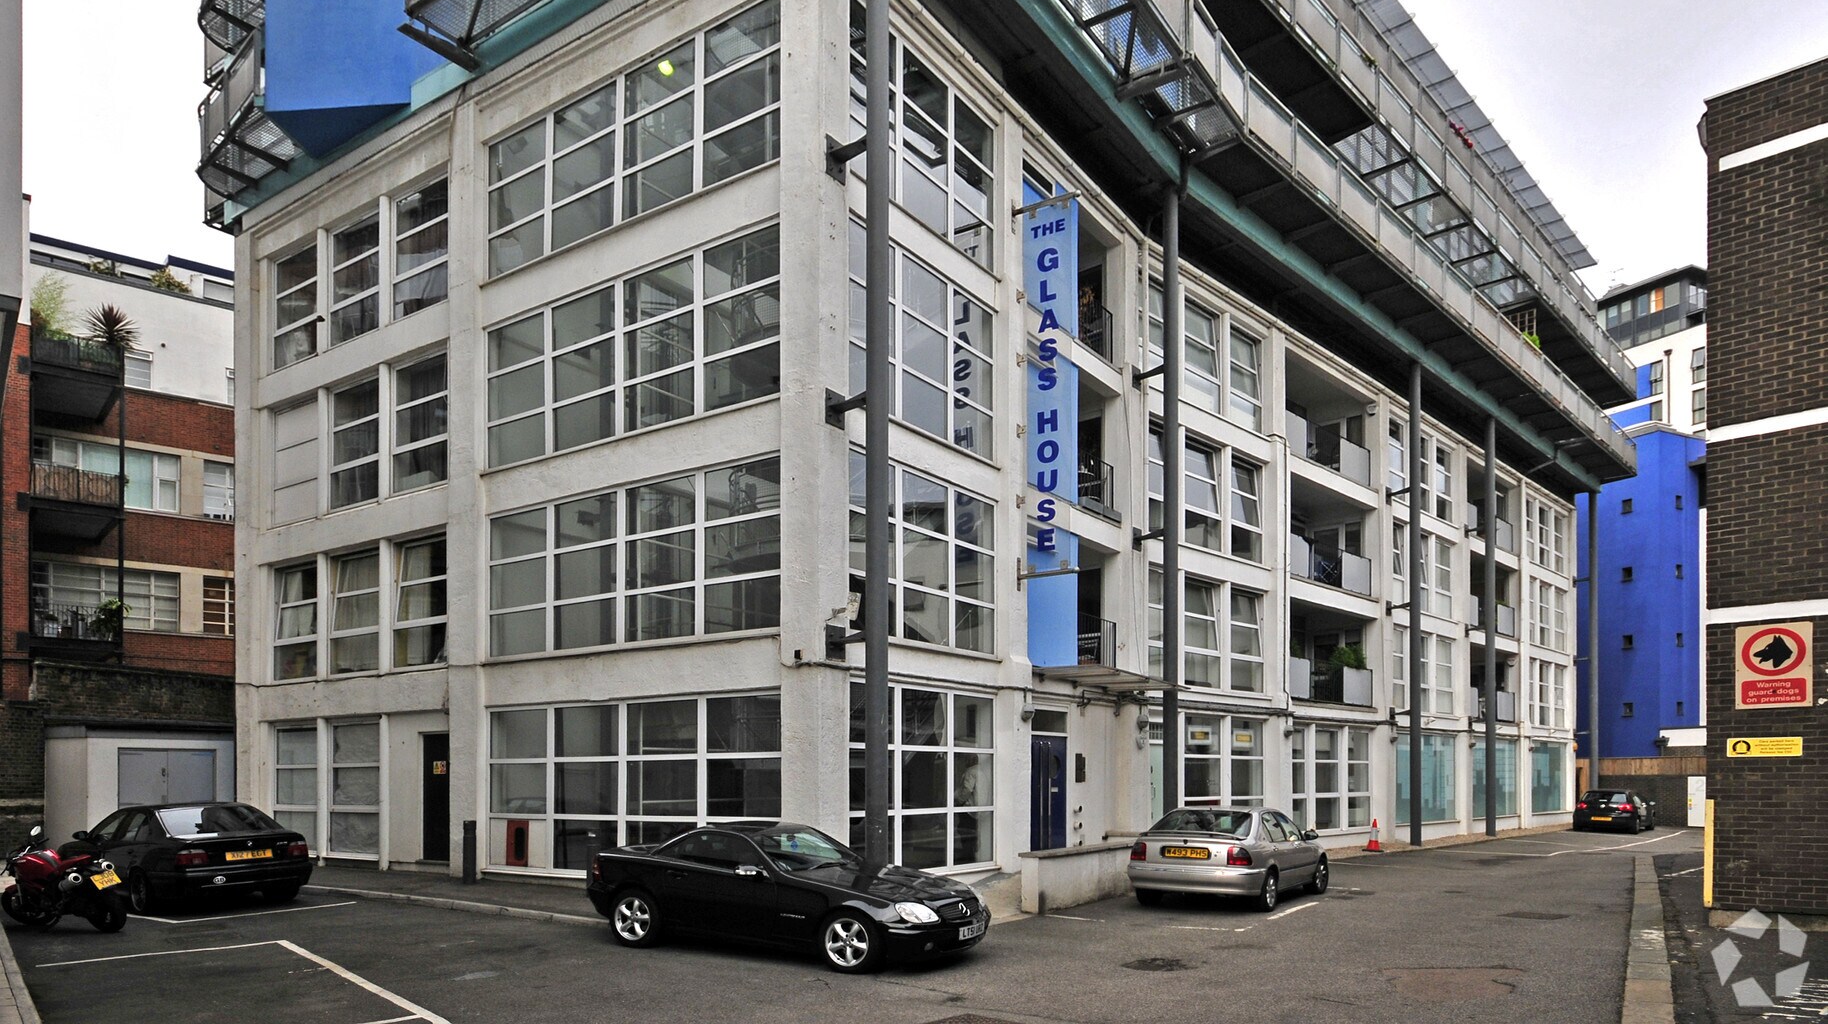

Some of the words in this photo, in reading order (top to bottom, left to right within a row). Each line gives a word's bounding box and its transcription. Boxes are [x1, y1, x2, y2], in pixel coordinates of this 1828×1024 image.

[1031, 218, 1066, 239] THE
[1036, 247, 1060, 391] GLASS
[1036, 409, 1060, 552] HOUSE
[1761, 695, 1801, 703] premises
[1190, 849, 1207, 857] PHS
